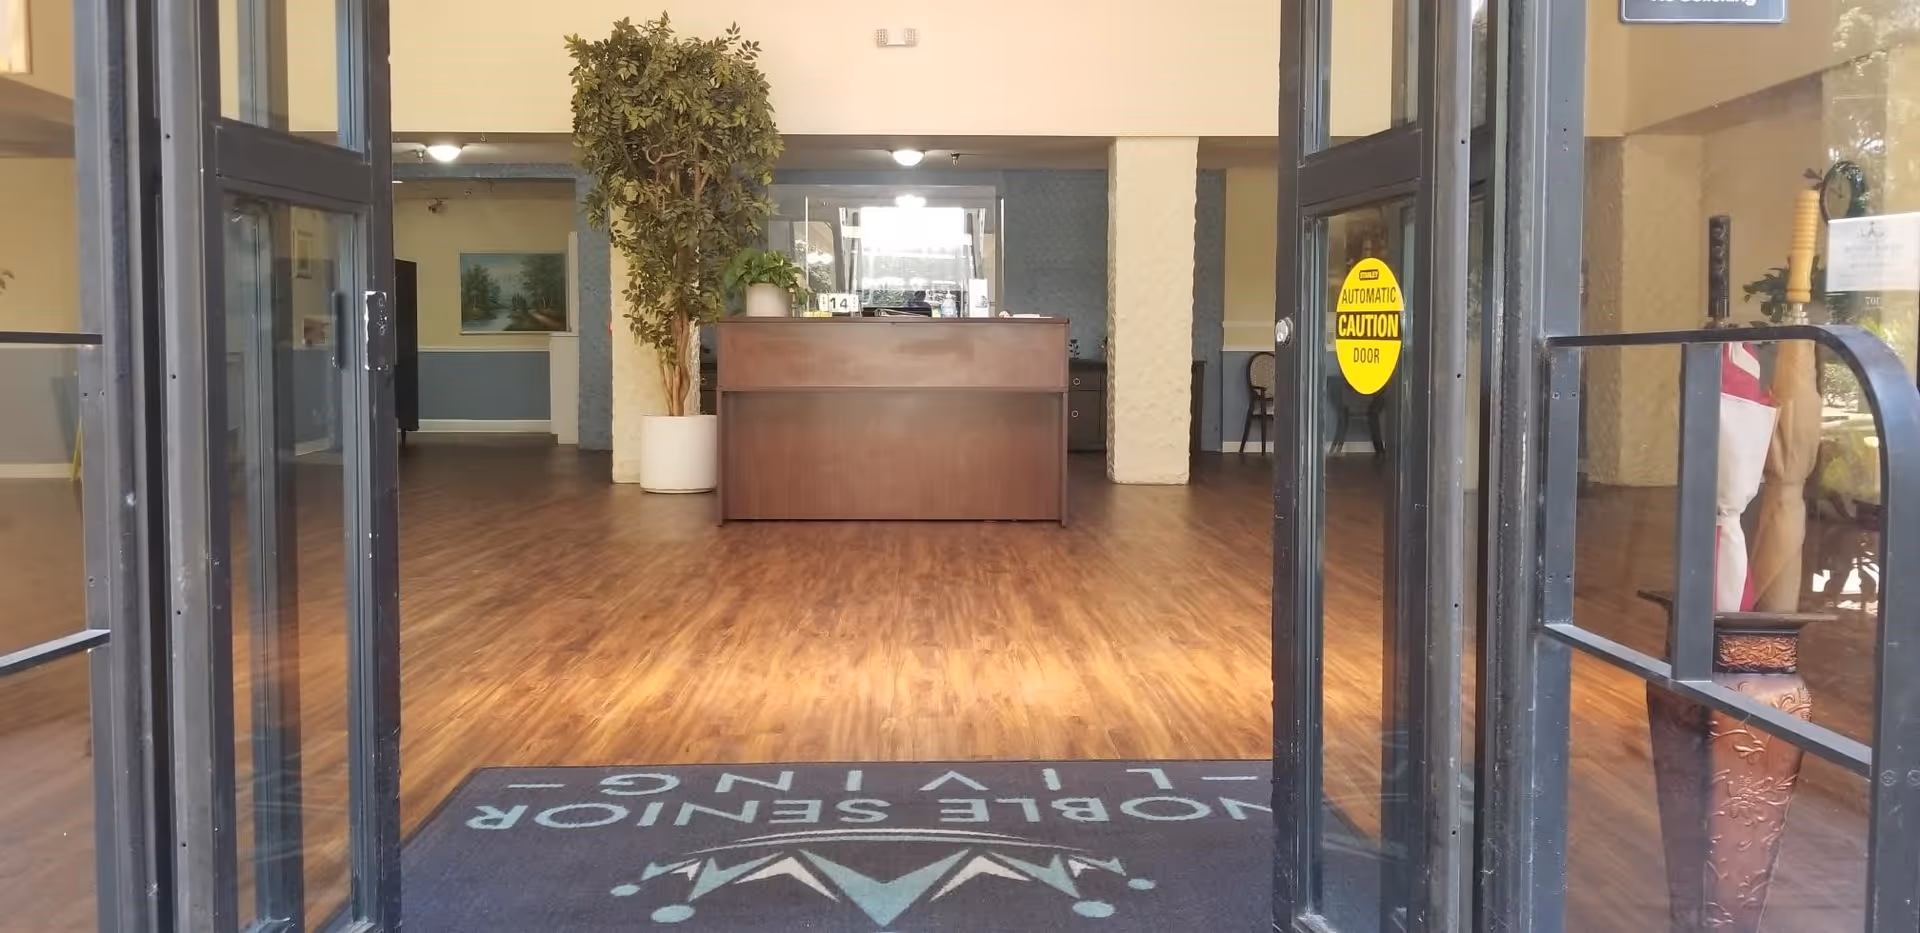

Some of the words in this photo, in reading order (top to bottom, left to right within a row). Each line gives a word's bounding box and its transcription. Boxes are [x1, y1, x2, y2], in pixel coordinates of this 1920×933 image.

[830, 297, 849, 309] 14
[1341, 286, 1397, 304] AUTOMATIC
[1338, 313, 1399, 338] CAUTION
[1353, 347, 1380, 364] DOOR
[600, 768, 1173, 796] LIVING
[465, 798, 892, 830] SENIOR
[937, 795, 1272, 823] NOBLE
